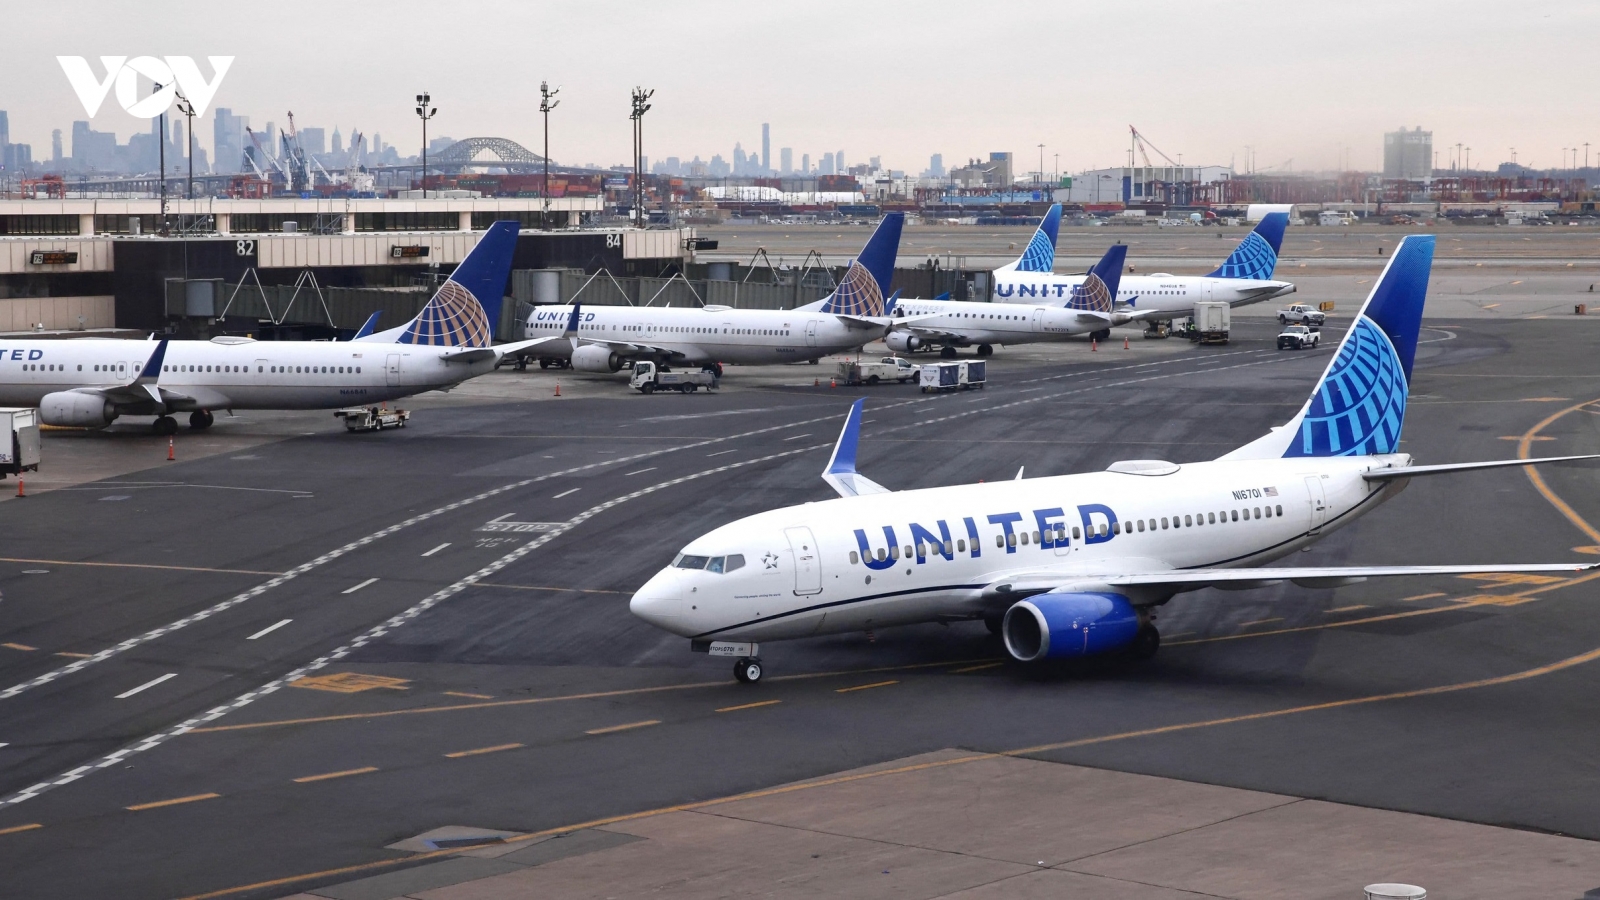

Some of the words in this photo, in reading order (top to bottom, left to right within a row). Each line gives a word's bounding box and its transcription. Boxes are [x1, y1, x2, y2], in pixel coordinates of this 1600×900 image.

[236, 239, 254, 256] 82
[606, 234, 621, 249] 84
[34, 255, 43, 263] 75
[1232, 488, 1262, 500] N16701
[481, 524, 549, 532] STOP
[853, 503, 1118, 571] UNITED
